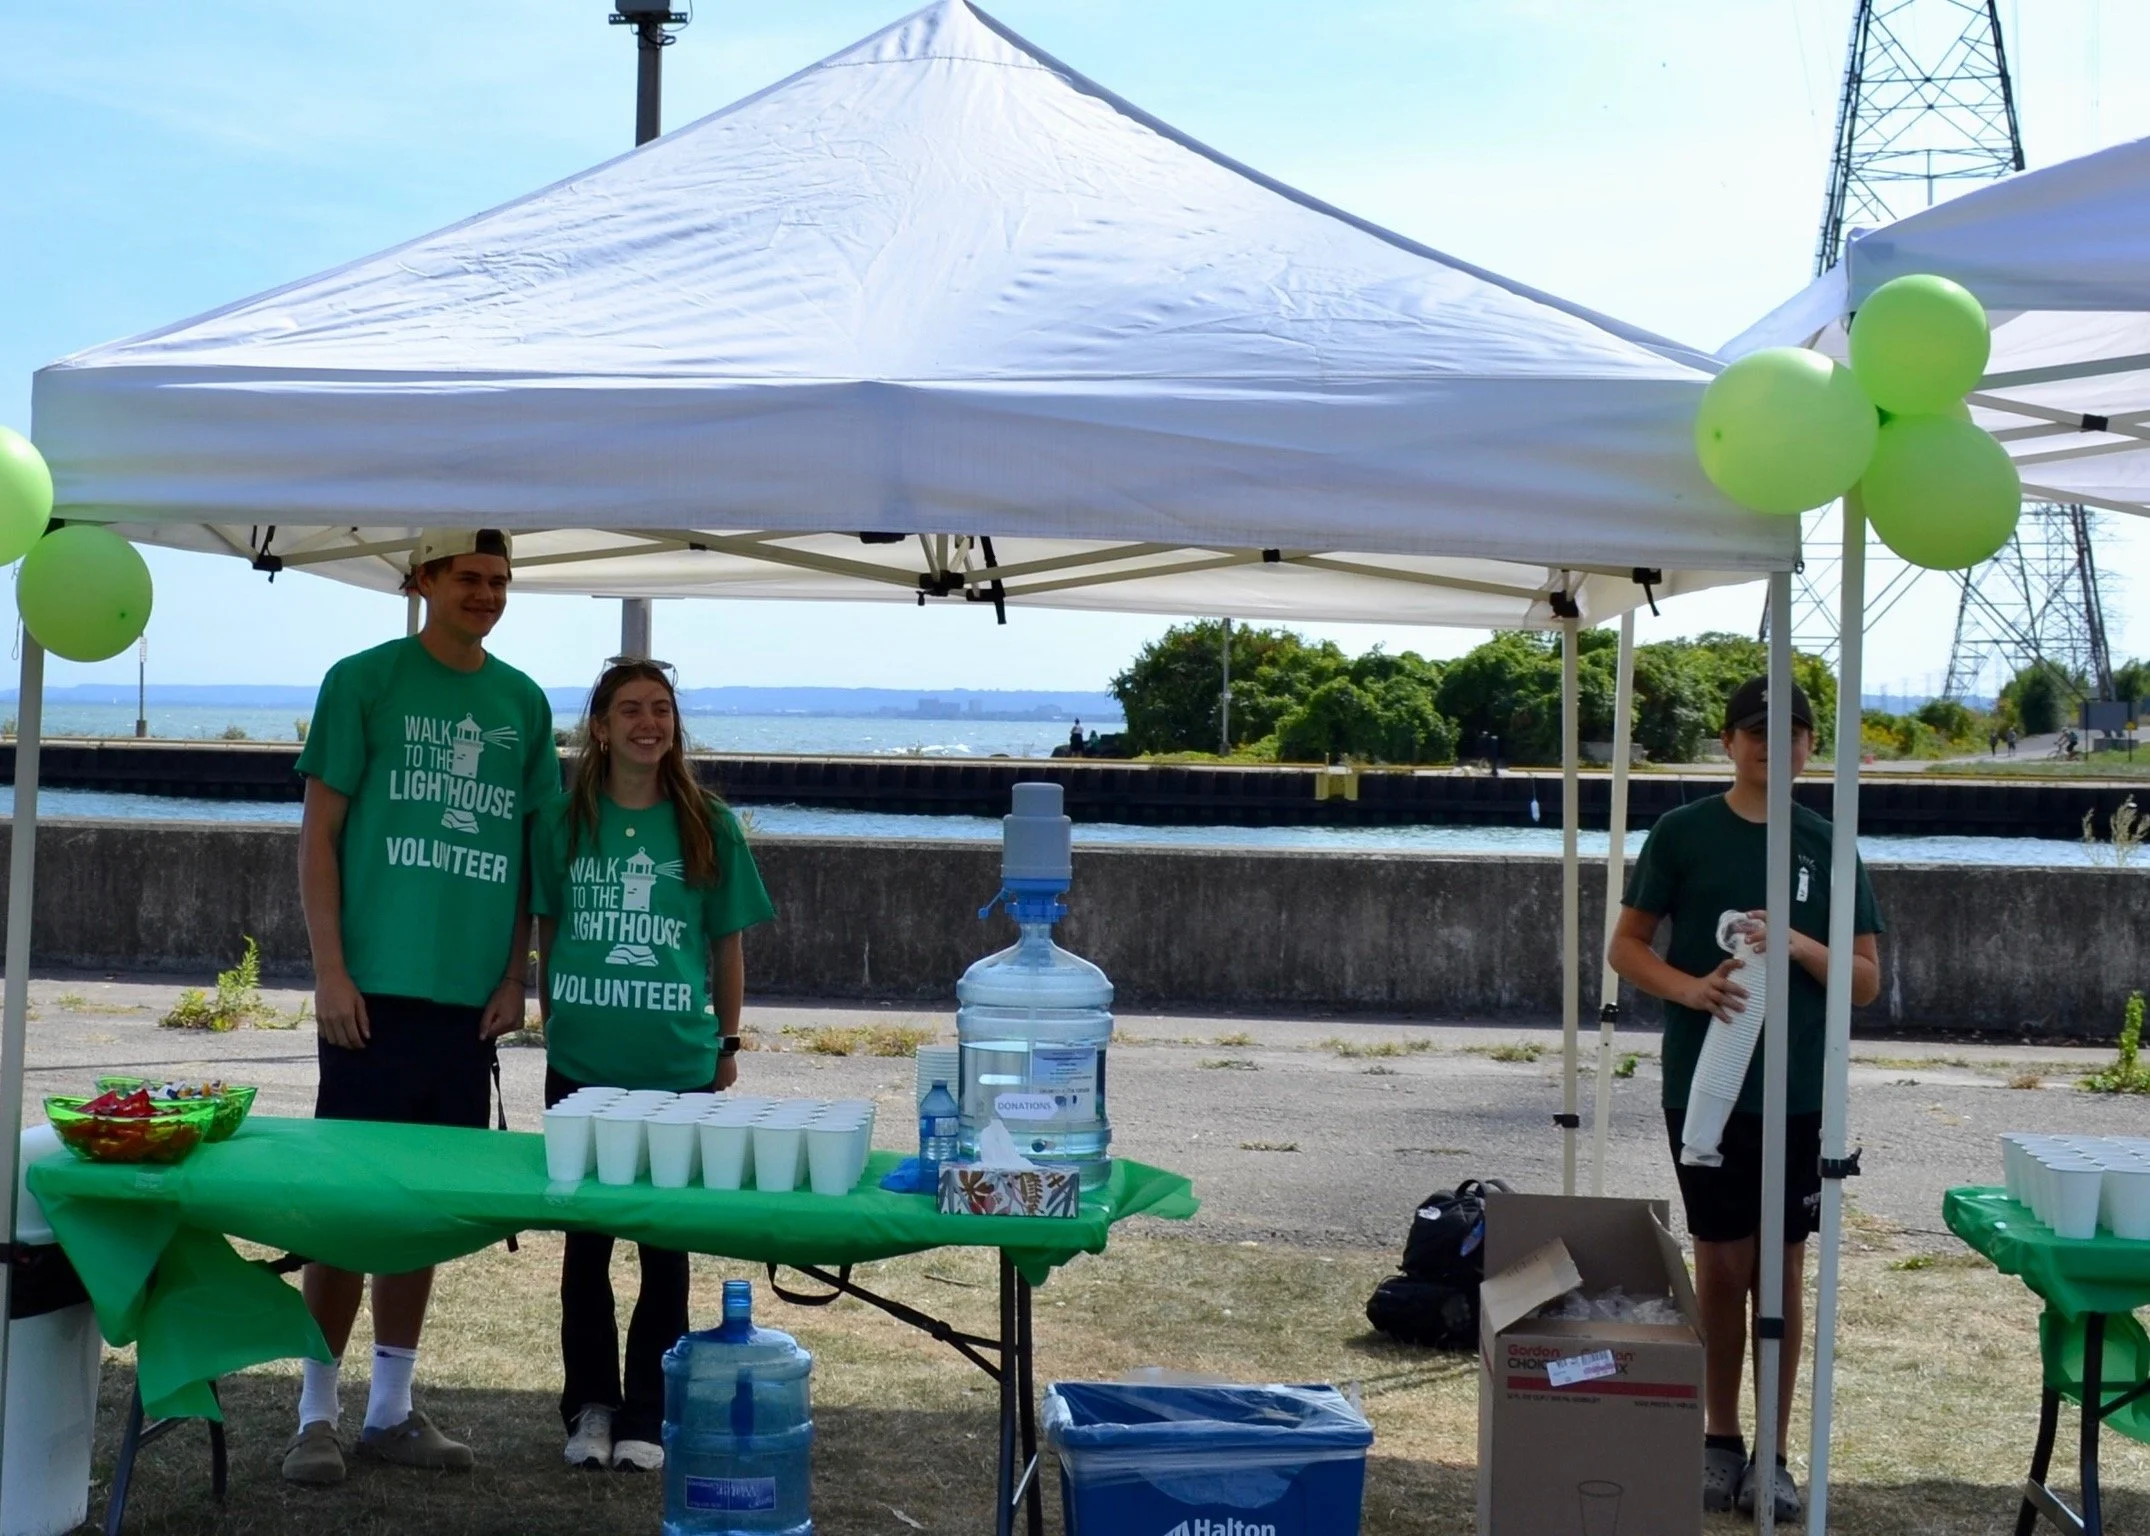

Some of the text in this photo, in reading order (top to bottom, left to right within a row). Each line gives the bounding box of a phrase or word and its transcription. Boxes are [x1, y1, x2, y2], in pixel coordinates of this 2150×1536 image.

[404, 715, 453, 746] WALK
[404, 744, 455, 773] TO THE
[389, 769, 516, 820] LIGHTHOUSE
[386, 836, 508, 884] VOLUNTEER
[569, 857, 620, 883] WALK
[571, 885, 621, 909] TO THE
[552, 972, 692, 1012] VOLUNTEER
[997, 1102, 1052, 1111] DONATIONS
[1507, 1344, 1560, 1357] Gordon
[1194, 1517, 1276, 1536] Halton
